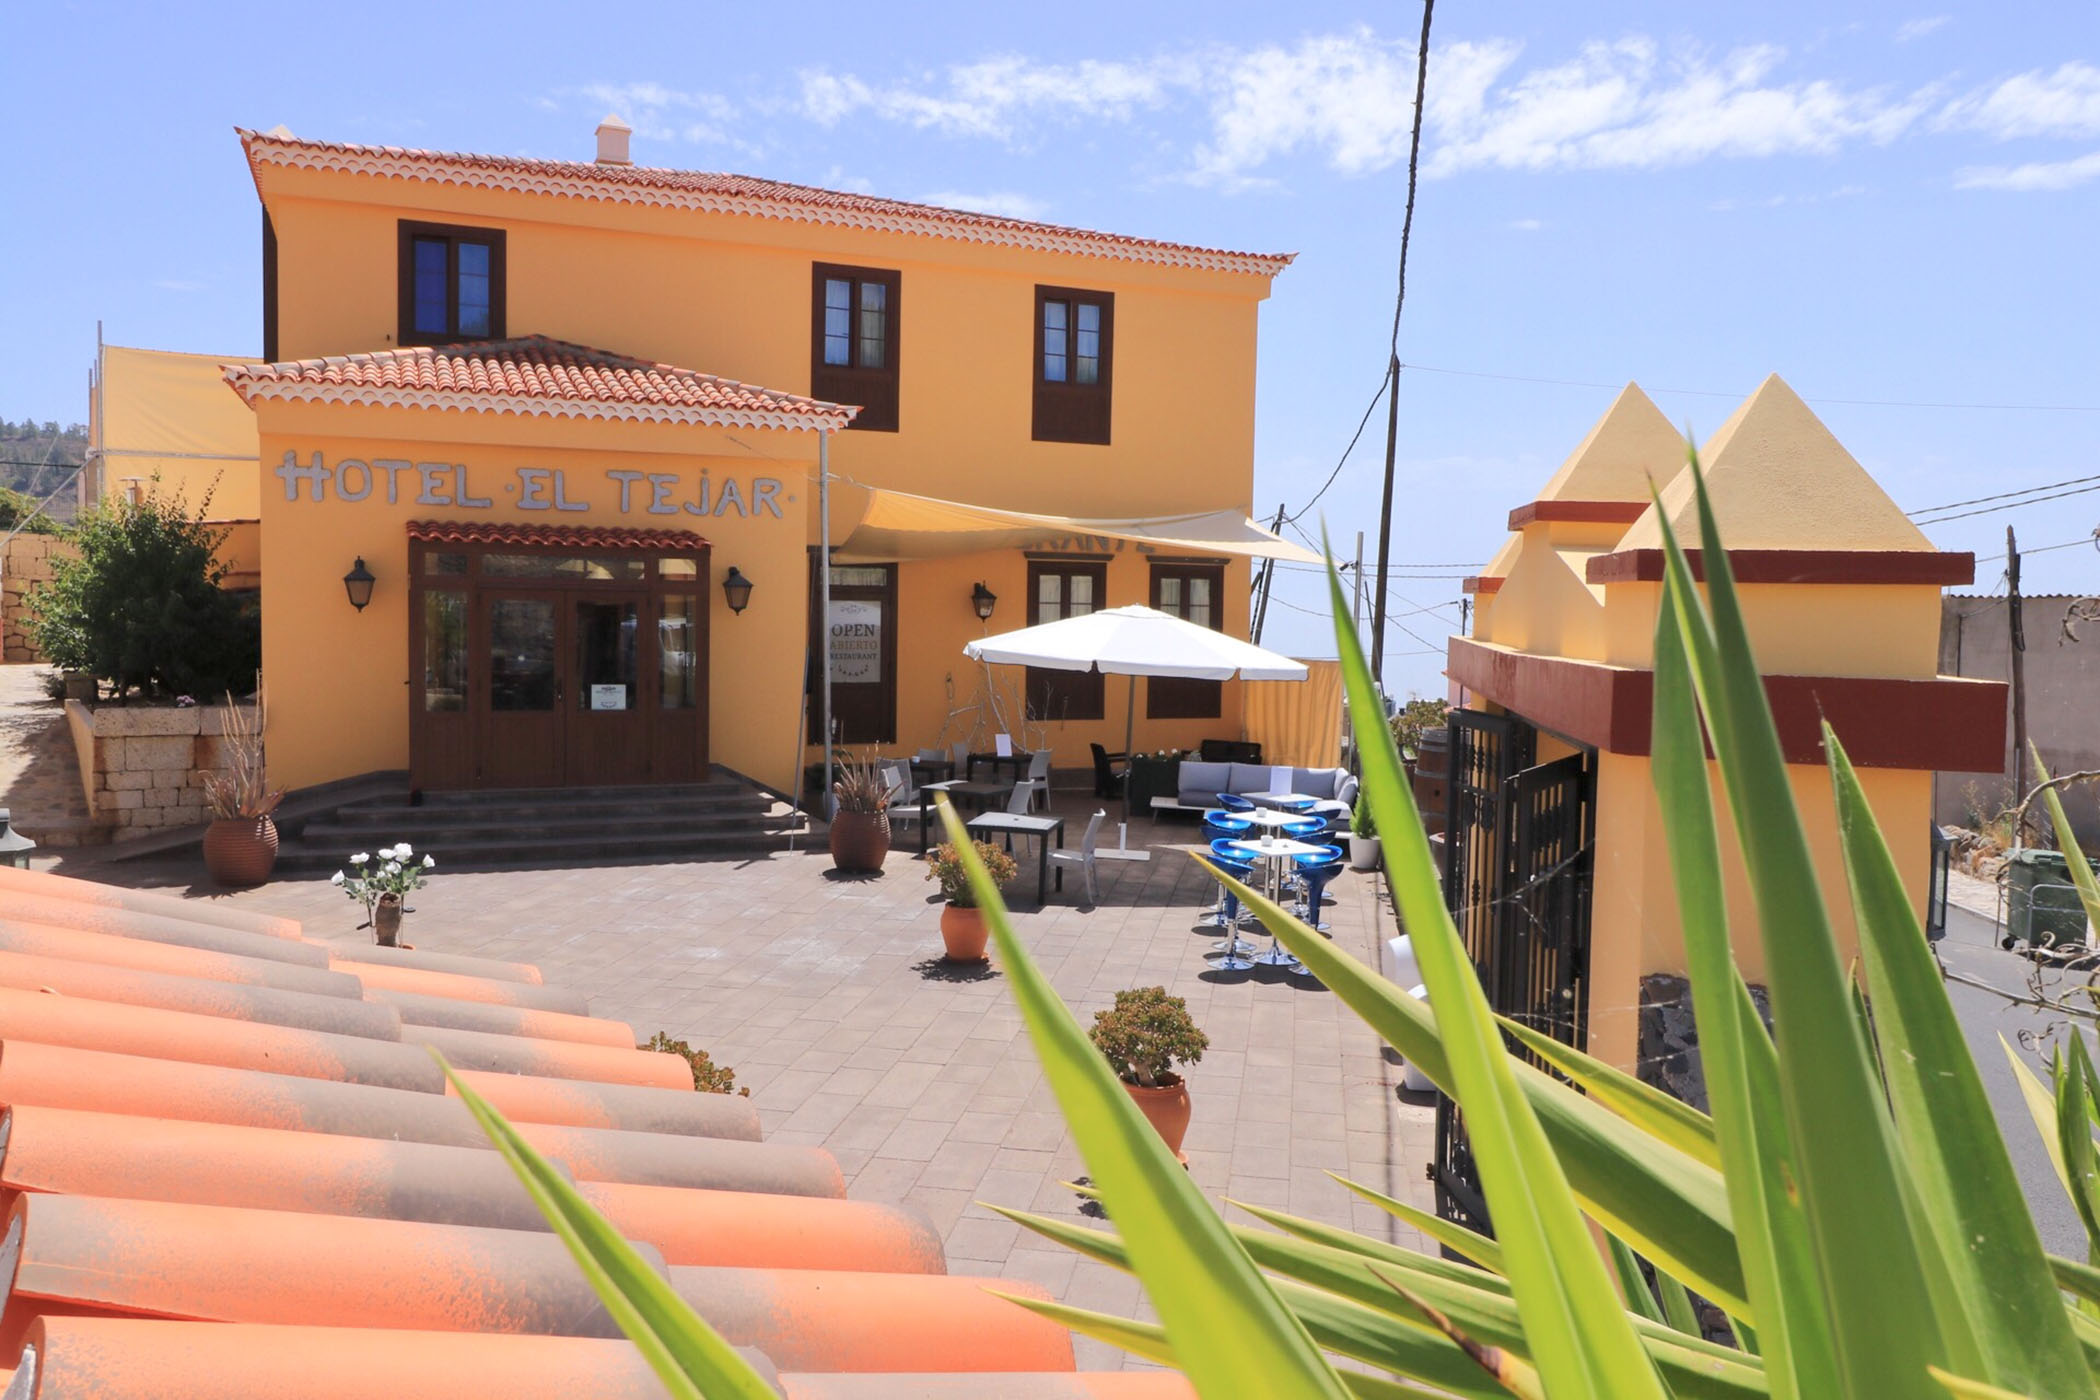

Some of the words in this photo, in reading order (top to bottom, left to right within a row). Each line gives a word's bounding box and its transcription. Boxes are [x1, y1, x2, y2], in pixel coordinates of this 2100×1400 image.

[275, 449, 492, 508] HOTEL
[831, 623, 876, 637] OPEN
[830, 640, 878, 650] ABIERTO
